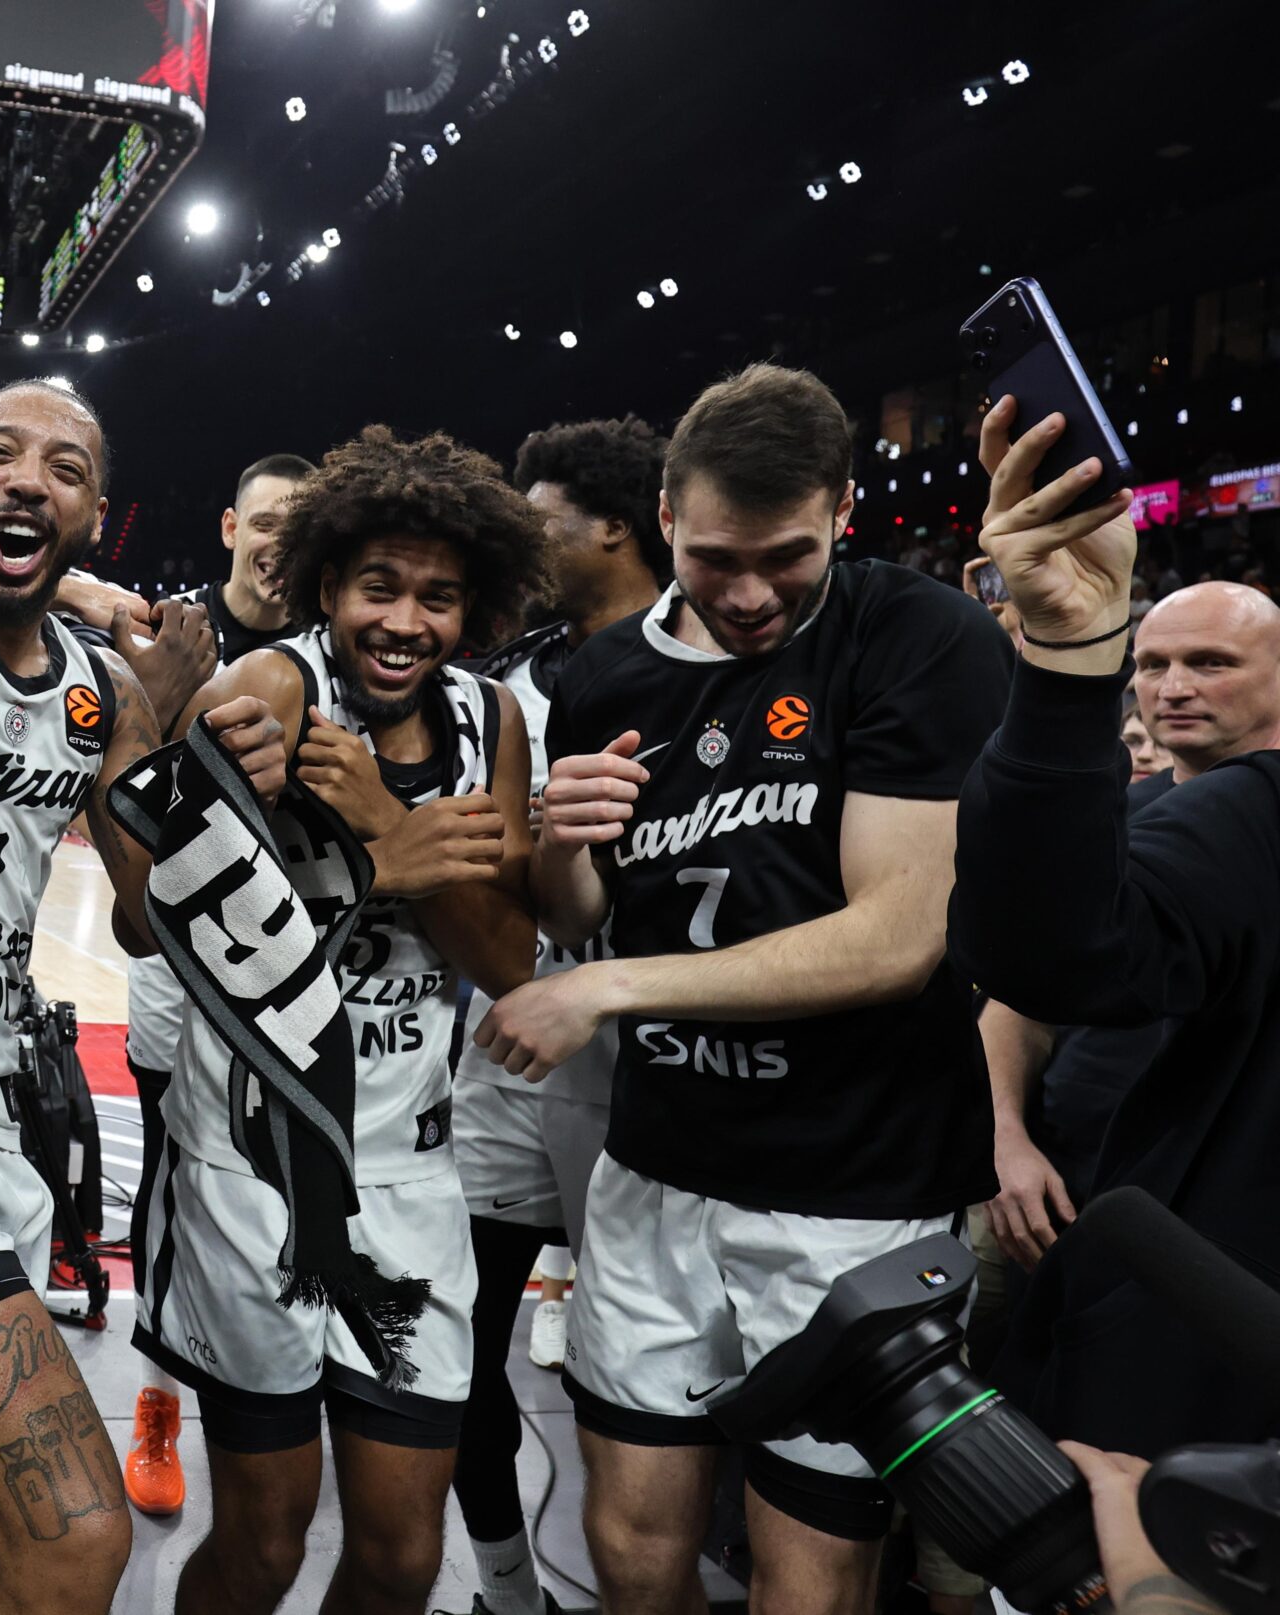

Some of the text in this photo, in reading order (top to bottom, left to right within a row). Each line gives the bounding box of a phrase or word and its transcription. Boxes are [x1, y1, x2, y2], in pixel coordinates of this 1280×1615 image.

[4, 62, 84, 92] siegmund
[94, 76, 171, 105] siegmund
[68, 736, 101, 750] ETIHAD
[762, 751, 806, 761] ETIHAD
[675, 867, 731, 949] 7
[188, 1335, 218, 1364] mts
